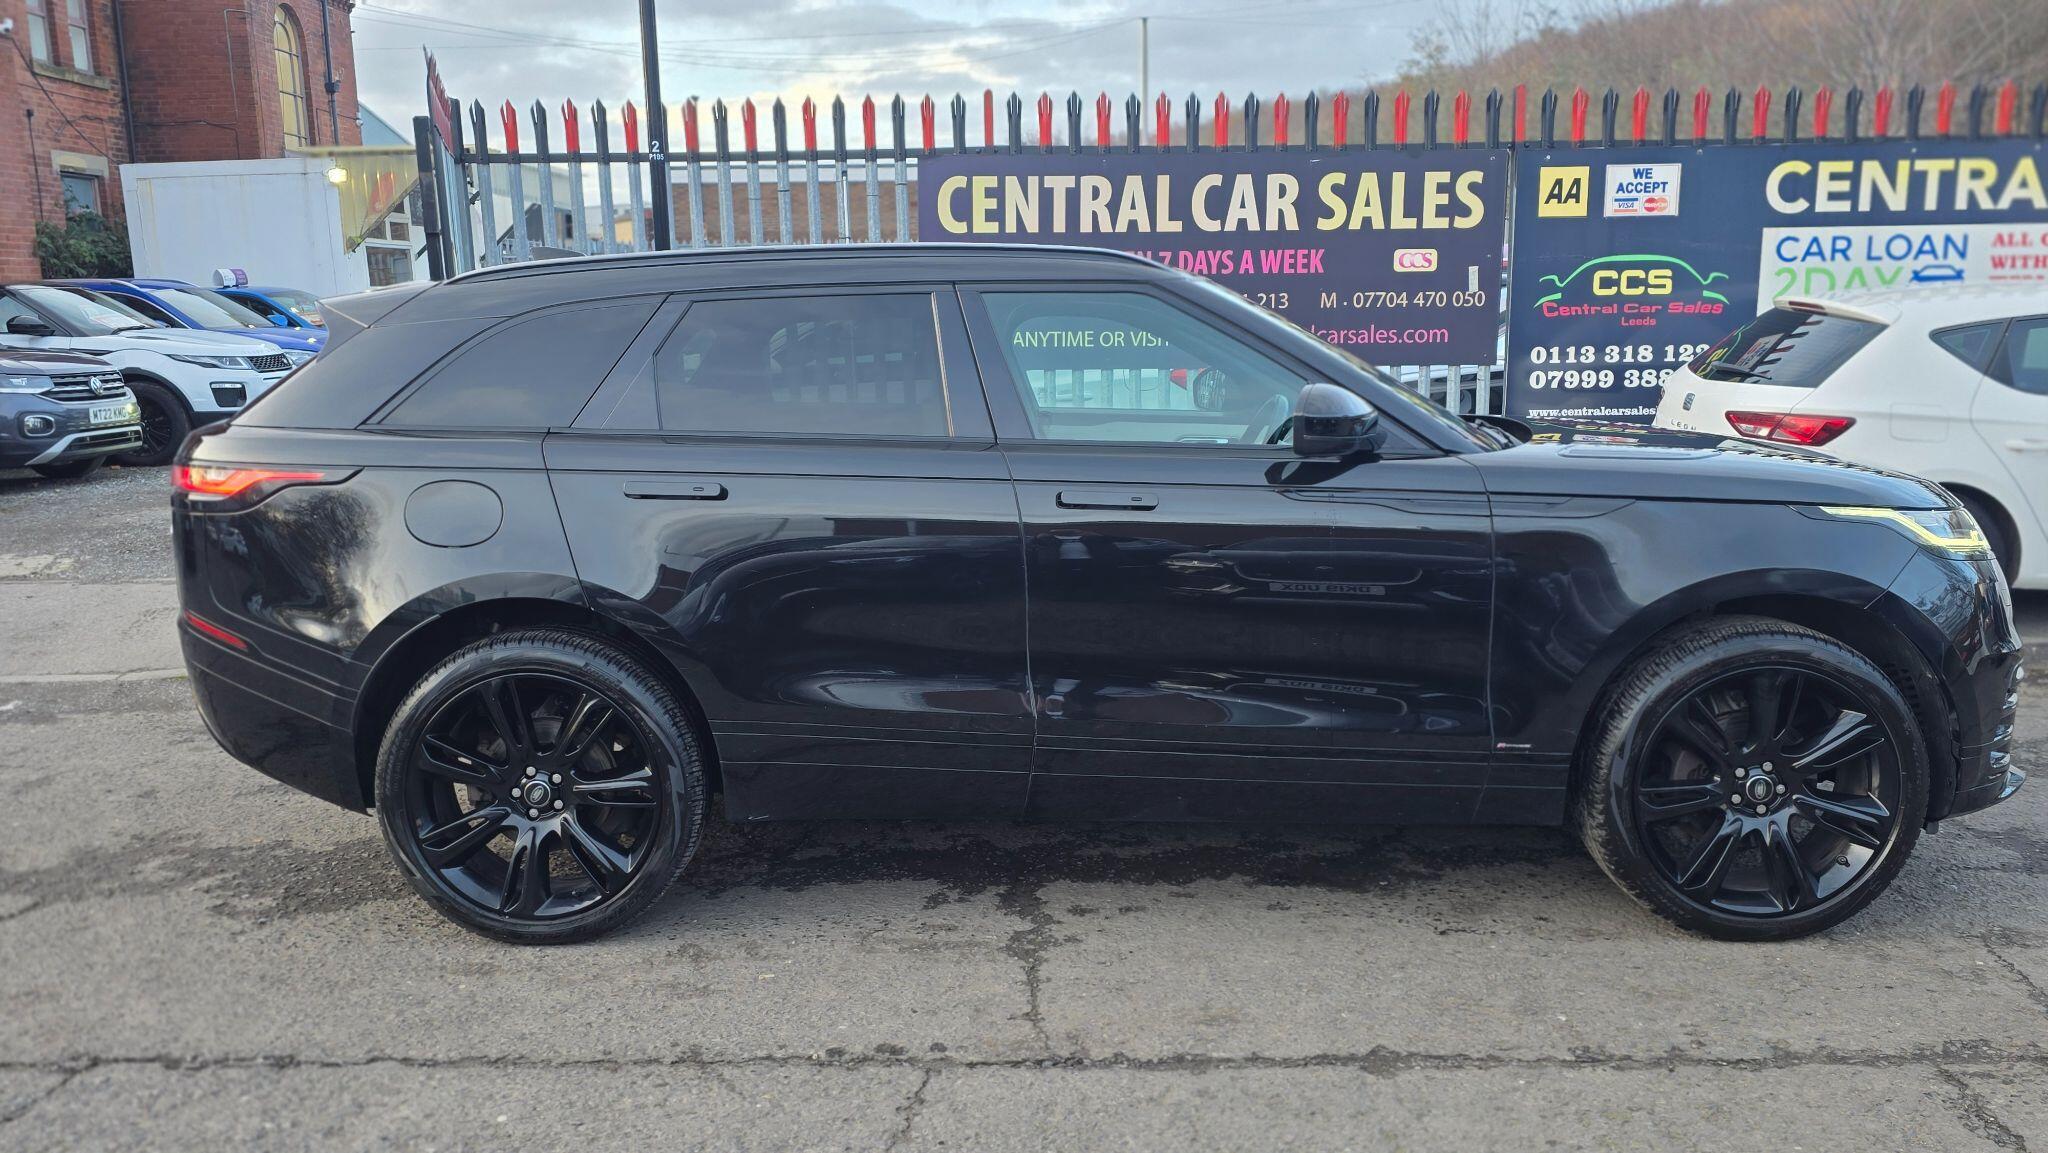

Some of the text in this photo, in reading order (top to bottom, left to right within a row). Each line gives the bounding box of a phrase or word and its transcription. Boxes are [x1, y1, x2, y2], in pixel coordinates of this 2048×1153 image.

[651, 140, 660, 153] 2
[1633, 167, 1653, 180] WE
[1544, 177, 1582, 205] AA
[1616, 181, 1668, 194] ACCEPT
[937, 170, 1485, 234] CENTRAL CAR SALES
[1776, 233, 1969, 263] CAR LOAN
[1992, 232, 2033, 248] ALL
[1179, 250, 1234, 275] DAYS
[1238, 250, 1254, 274] A
[1260, 249, 1325, 274] WEEK
[1398, 252, 1433, 269] CCS
[1592, 269, 1673, 296] CCS
[1257, 292, 1289, 309] 213
[1320, 293, 1337, 309] M
[1353, 292, 1408, 309] 07704
[1413, 291, 1447, 308] 470
[1452, 290, 1486, 308] 050
[1542, 301, 1724, 317] Central Car Sales
[1621, 317, 1657, 326] Leeds
[1013, 331, 1168, 347] ANYTIME OR VISI
[1530, 346, 1596, 364] 0113
[1604, 345, 1654, 363] 318
[1529, 370, 1615, 389] 07999
